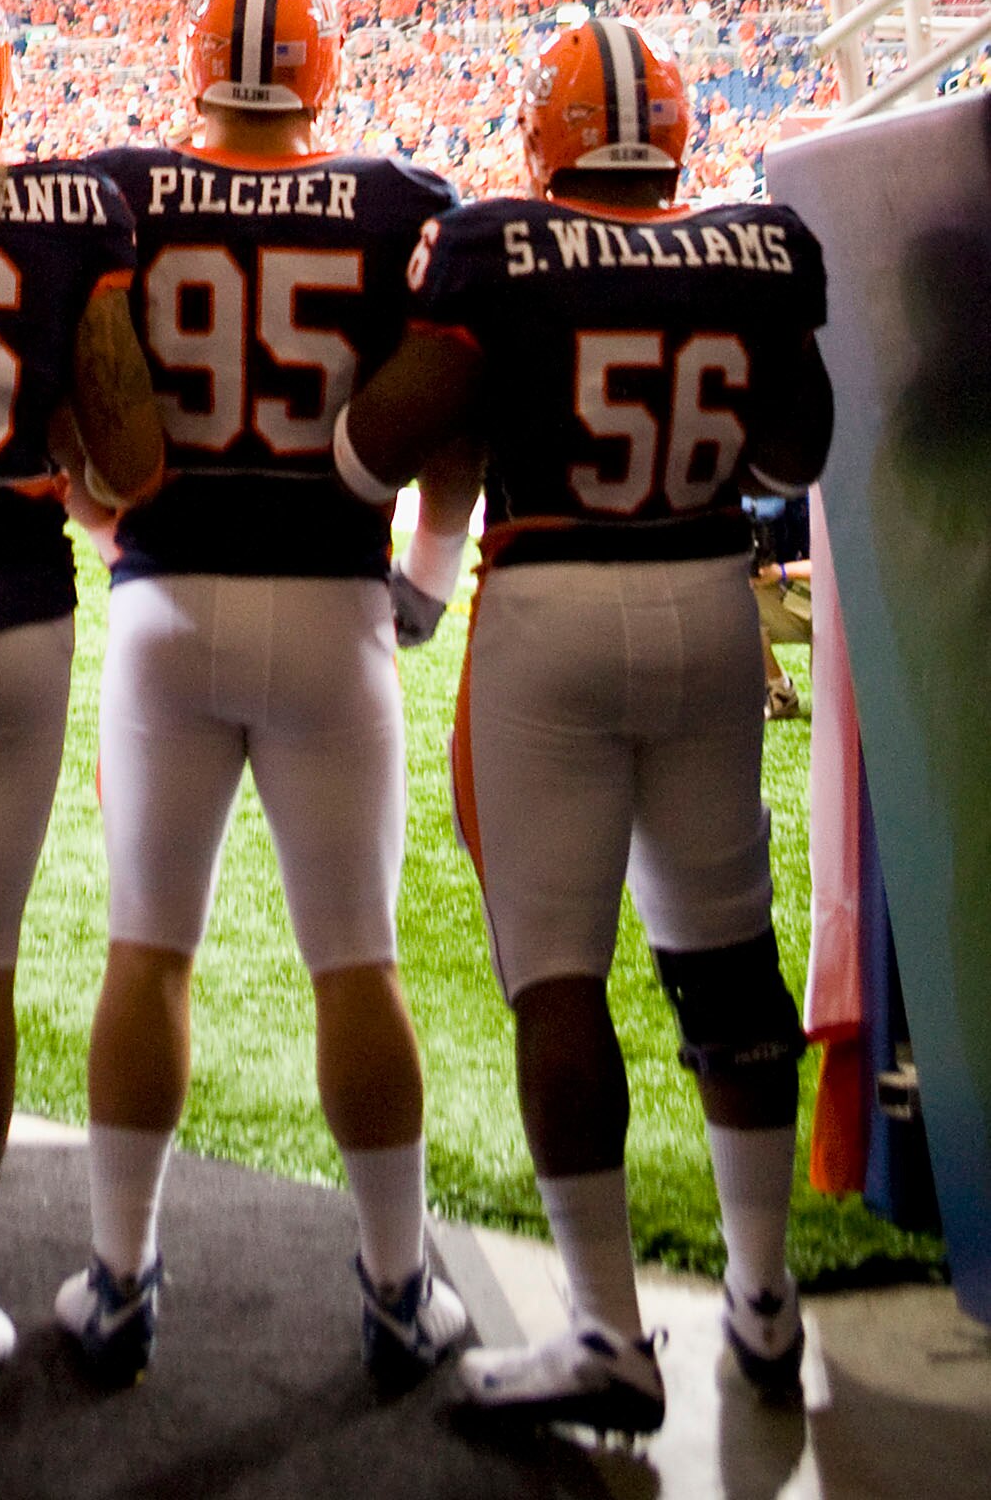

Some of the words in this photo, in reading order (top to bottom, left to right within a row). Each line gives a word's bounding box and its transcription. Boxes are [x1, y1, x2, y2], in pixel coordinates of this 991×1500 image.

[148, 166, 358, 221] PILCHER
[144, 244, 365, 456] 95
[568, 328, 750, 515] 56
